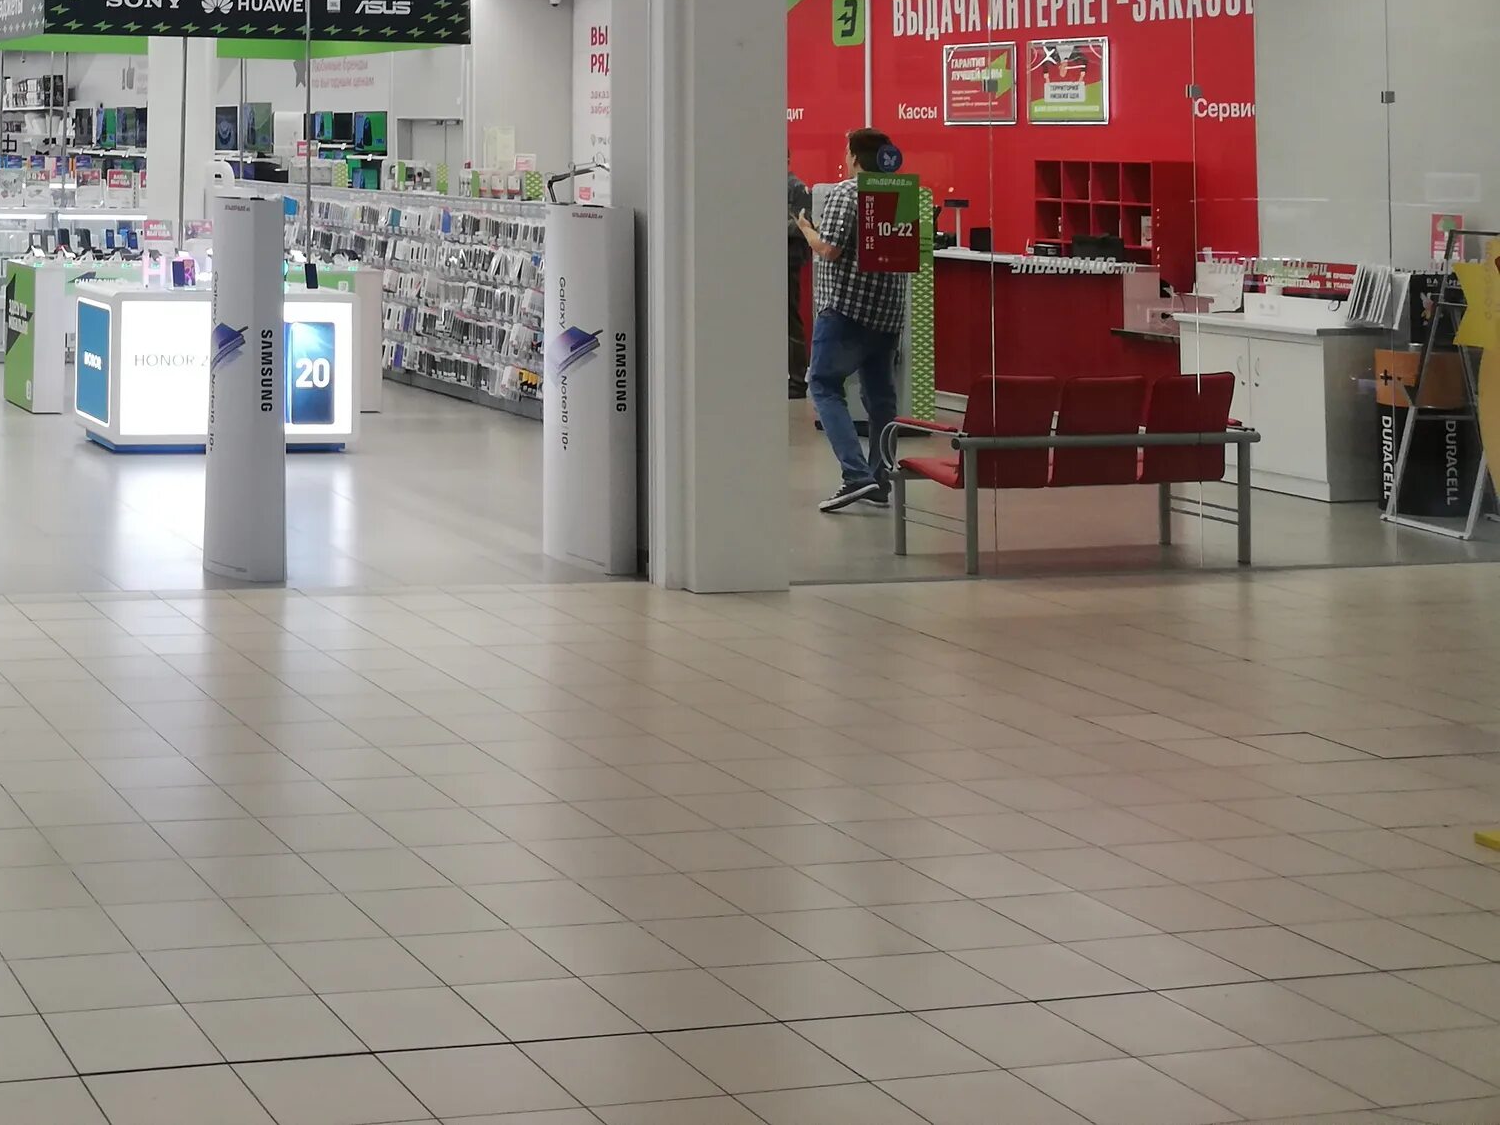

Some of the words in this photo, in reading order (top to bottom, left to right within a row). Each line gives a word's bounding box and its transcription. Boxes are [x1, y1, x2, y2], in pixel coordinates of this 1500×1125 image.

[355, 0, 412, 15] ASUS
[898, 103, 938, 120] Кассы
[877, 221, 913, 236] 10-22
[134, 354, 194, 368] HONOR
[260, 328, 273, 413] SAMSUNG
[295, 357, 330, 388] 20
[615, 332, 627, 413] SAMSUNG
[1382, 415, 1394, 500] DURACELL
[1445, 420, 1459, 506] DURACELL
